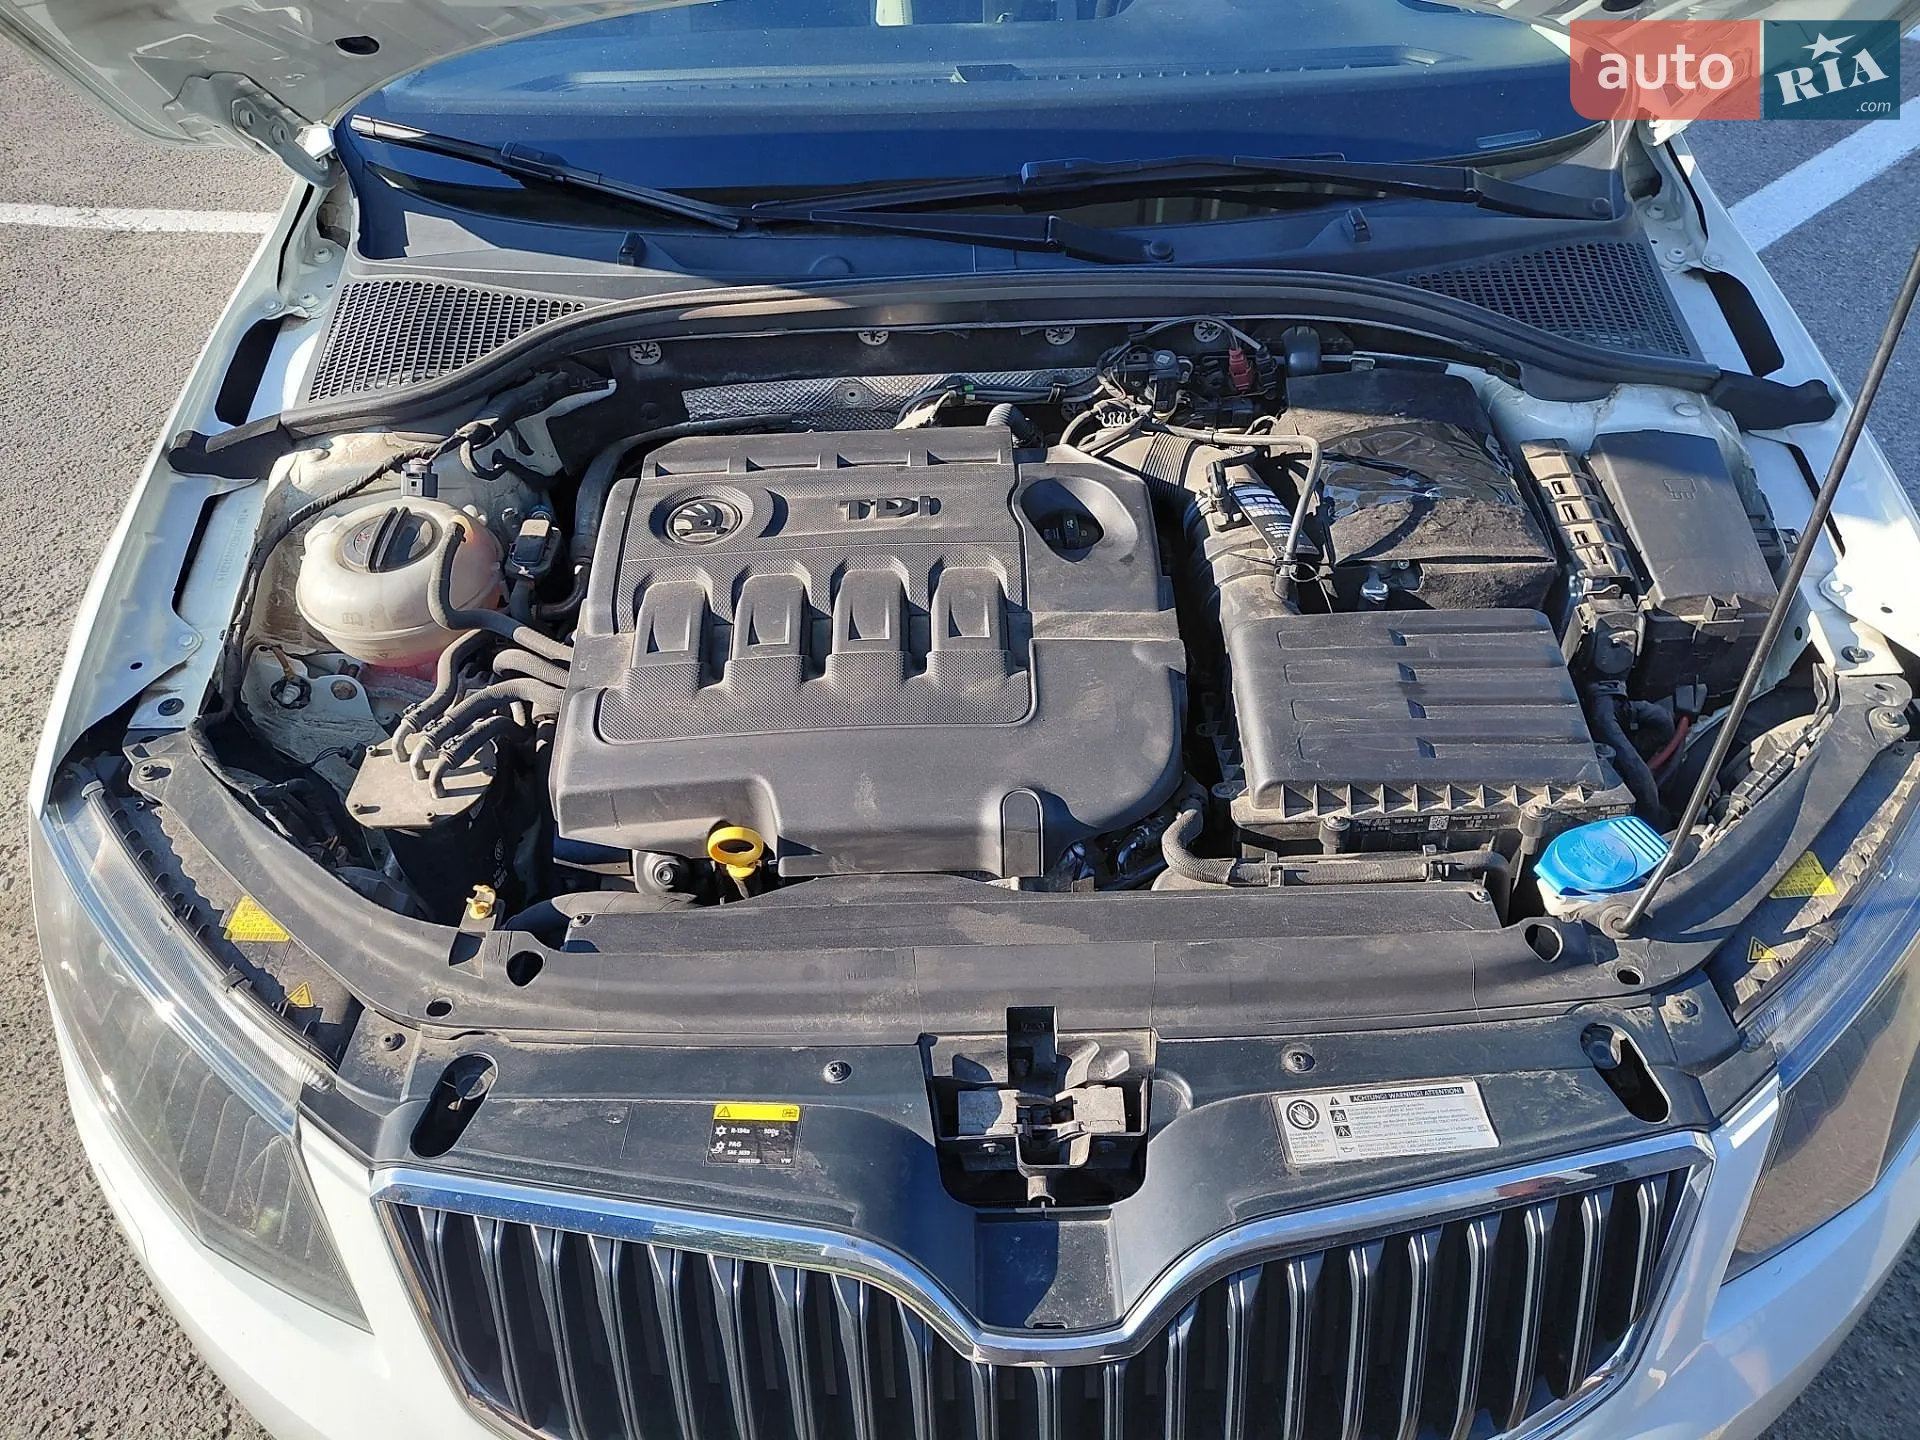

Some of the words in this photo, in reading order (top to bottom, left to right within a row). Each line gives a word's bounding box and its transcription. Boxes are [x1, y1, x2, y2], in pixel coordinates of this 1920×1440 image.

[839, 495, 942, 520] TDI
[1352, 1092, 1388, 1102] ACHTUNG!
[1388, 1090, 1423, 1100] WARNING!
[1424, 1087, 1463, 1097] ATTENTION!
